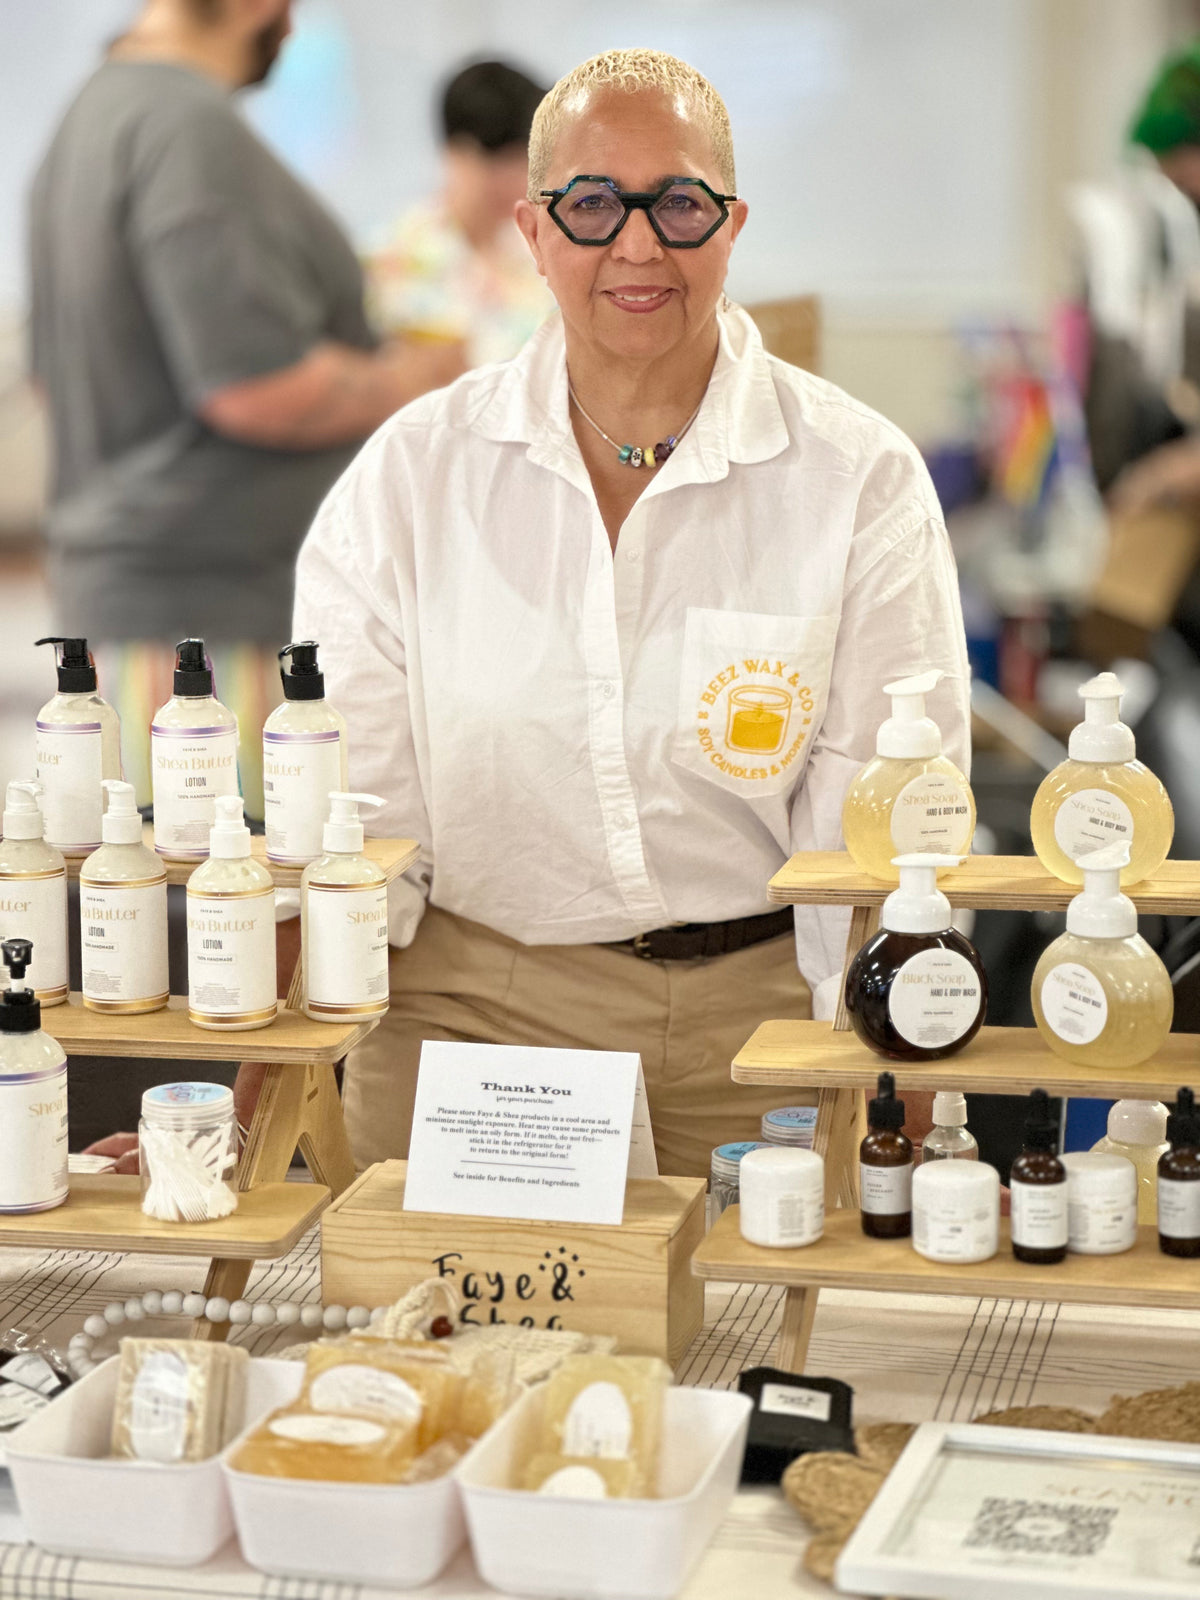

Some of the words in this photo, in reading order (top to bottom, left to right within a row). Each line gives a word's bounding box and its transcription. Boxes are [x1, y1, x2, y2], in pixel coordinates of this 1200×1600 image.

[701, 664, 740, 706] BEEZ
[742, 658, 787, 678] WAX
[787, 672, 800, 687] &
[798, 686, 814, 712] CO
[698, 727, 716, 753] SOY
[710, 753, 768, 779] CANDLES
[770, 764, 780, 776] &
[780, 732, 806, 769] MORE
[157, 756, 189, 770] Shea
[191, 755, 233, 770] Butter
[185, 777, 207, 788] LOTION
[92, 907, 140, 921] Butter
[88, 926, 105, 937] LOTION
[208, 919, 257, 932] Butter
[203, 939, 223, 950] LOTION
[902, 973, 934, 985] Black
[936, 973, 966, 986] Soap
[931, 988, 943, 997] HAND
[944, 988, 948, 996] &
[949, 988, 962, 996] BODY
[963, 988, 977, 997] WASH
[481, 1082, 536, 1094] Thank
[540, 1086, 572, 1096] You
[437, 1106, 458, 1115] Please
[459, 1108, 476, 1116] store
[477, 1110, 493, 1118] Faye
[520, 1113, 550, 1121] products
[552, 1114, 558, 1122] in
[425, 1116, 456, 1124] minimize
[457, 1118, 484, 1126] sunlight
[485, 1120, 518, 1128] exposure.
[591, 1127, 620, 1135] products
[490, 1129, 501, 1137] oily
[504, 1130, 522, 1138] form.
[513, 1140, 553, 1149] refrigerator
[521, 1150, 548, 1158] original
[466, 1173, 486, 1181] inside
[487, 1174, 497, 1182] for
[499, 1175, 526, 1183] Benefits
[541, 1178, 580, 1187] Ingredients
[432, 1252, 536, 1304] Faye
[551, 1262, 575, 1302] &
